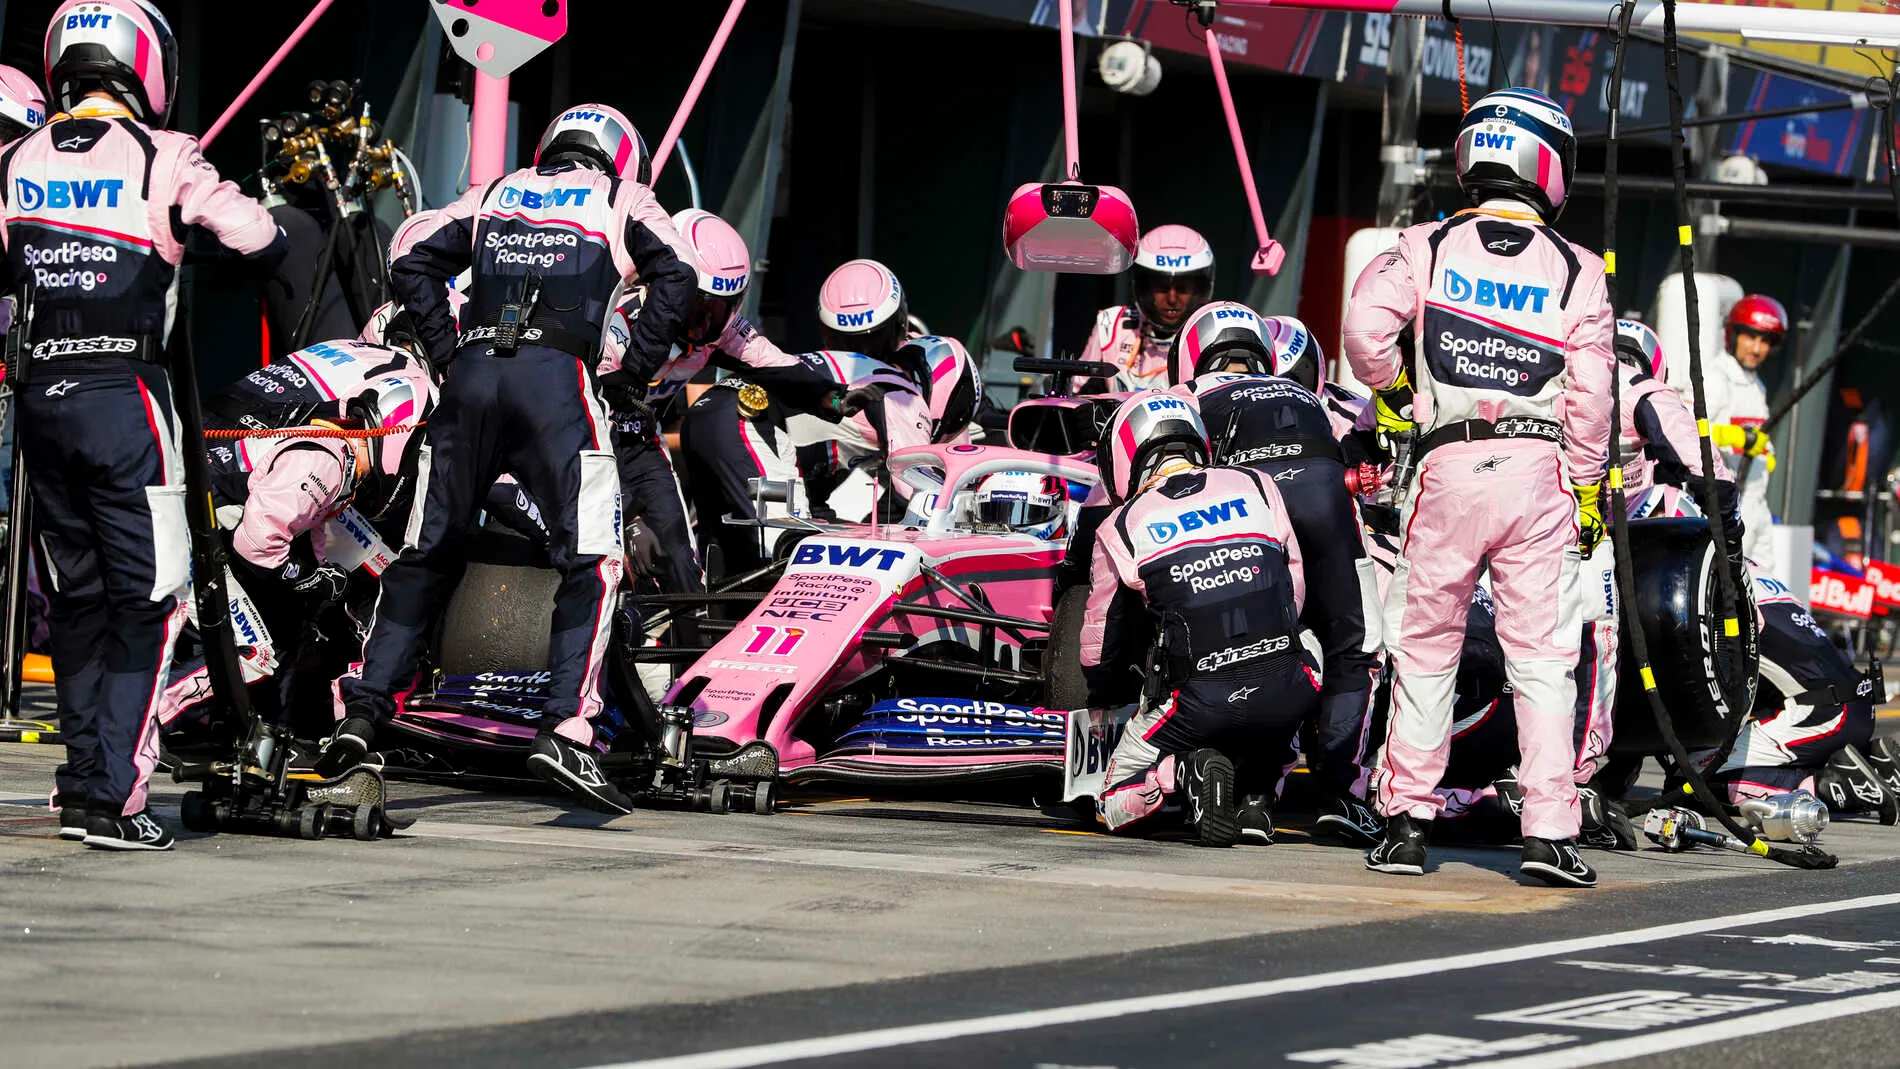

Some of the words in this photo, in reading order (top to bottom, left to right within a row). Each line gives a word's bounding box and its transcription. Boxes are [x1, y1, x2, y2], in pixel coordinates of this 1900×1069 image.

[66, 14, 112, 30] BWT
[26, 107, 46, 126] BW
[562, 111, 605, 123] BWT
[1474, 132, 1516, 150] BWT
[47, 179, 123, 209] BWT
[522, 188, 591, 209] BWT
[24, 242, 117, 268] SportPesa
[485, 232, 577, 257] SportPesa
[495, 250, 555, 267] Racing
[1156, 255, 1191, 267] BWT
[34, 268, 96, 291] Racing
[711, 274, 745, 292] BWT
[1475, 278, 1549, 313] BWT
[836, 310, 874, 327] BWT
[1216, 309, 1253, 321] BWT
[1618, 320, 1642, 331] WT
[32, 336, 137, 359] alpinestars
[1288, 330, 1306, 355] BWT
[1440, 331, 1540, 364] SportPesa
[303, 343, 356, 367] BWT
[261, 364, 307, 389] ortPesa
[1455, 356, 1519, 385] Racing
[1147, 399, 1185, 411] BWT
[1250, 391, 1310, 404] Racing
[1495, 418, 1563, 440] alpines
[1227, 443, 1302, 466] pinestars
[307, 471, 331, 497] infinitu
[1178, 498, 1249, 532] BWT
[613, 509, 622, 547] BWT
[791, 544, 905, 571] BWT
[1170, 543, 1263, 583] SportPesa
[788, 573, 872, 586] SportPesa
[794, 581, 847, 593] Racing
[1190, 566, 1252, 594] Racing
[774, 590, 858, 601] infinitum
[1606, 583, 1614, 616] BWT
[760, 609, 838, 622] NEC
[234, 612, 258, 645] BWT
[740, 624, 808, 656] 11
[1197, 636, 1289, 672] alpinestars
[1700, 622, 1730, 719] ZERO
[704, 688, 756, 697] SportPesa
[896, 699, 1064, 728] SportPesa
[926, 728, 1033, 747] Racing
[1087, 722, 1121, 775] BW
